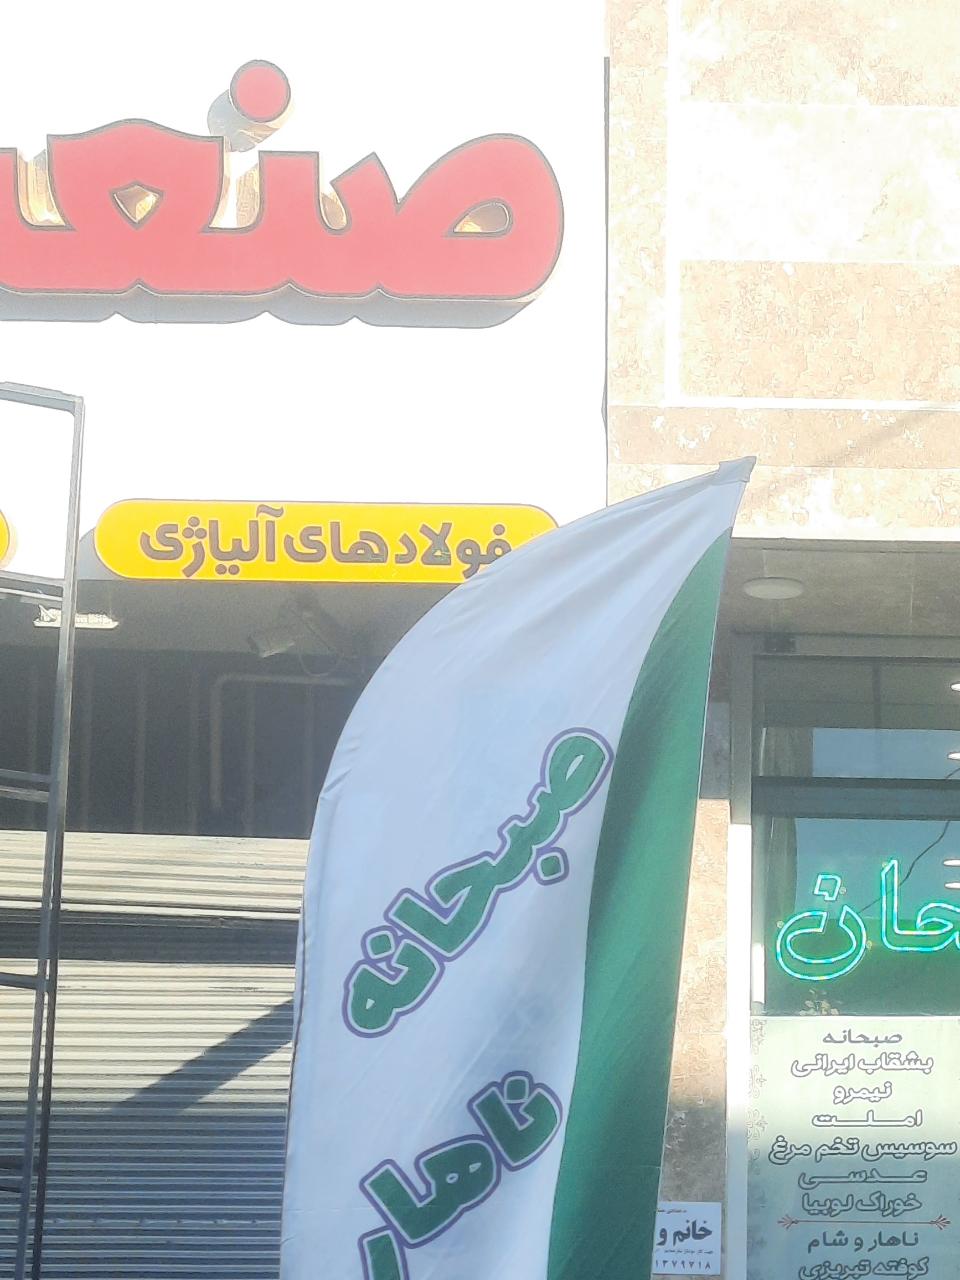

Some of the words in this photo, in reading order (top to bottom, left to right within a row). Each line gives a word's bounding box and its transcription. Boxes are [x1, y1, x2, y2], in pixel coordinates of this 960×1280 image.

[0, 60, 564, 316] صنع
[139, 506, 283, 578] آلیاژی
[341, 728, 614, 1038] صبحانه
[823, 1029, 903, 1047] صبحانه
[791, 1054, 855, 1077] ایرانی
[858, 1051, 934, 1075] بشقاب
[833, 1081, 892, 1104] نیمرو
[812, 1109, 923, 1127] املت
[769, 1135, 812, 1165] مرغ
[815, 1137, 860, 1163] تخم
[861, 1141, 957, 1161] سوسیس
[798, 1168, 928, 1190] عدسی
[802, 1193, 854, 1217] لوبیا
[856, 1191, 922, 1217] خوراک
[673, 1219, 713, 1246] خانم
[808, 1230, 849, 1253] شام
[854, 1237, 863, 1251] و
[868, 1231, 919, 1251] ناهار
[873, 1257, 930, 1279] کوفته
